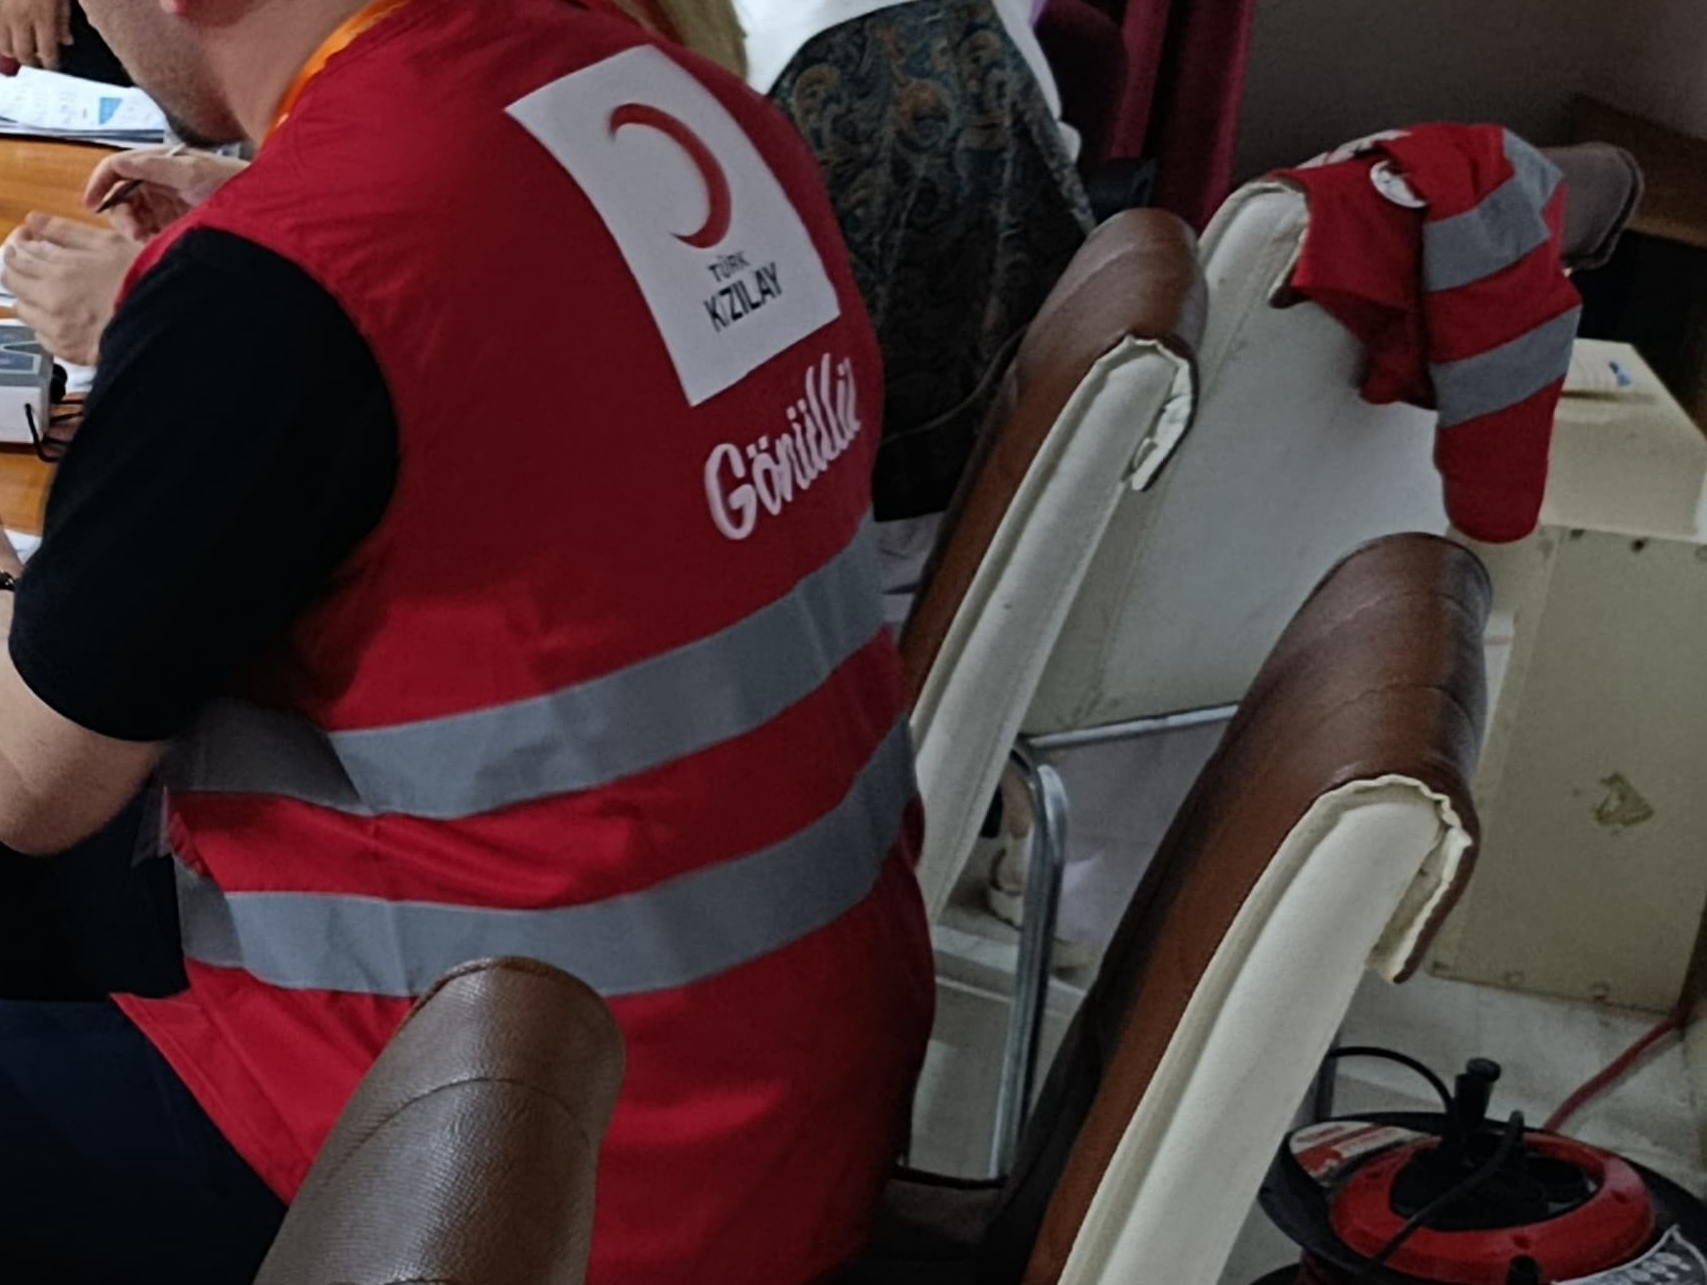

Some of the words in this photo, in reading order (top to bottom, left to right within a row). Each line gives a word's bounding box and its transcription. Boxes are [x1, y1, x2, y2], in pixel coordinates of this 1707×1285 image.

[703, 261, 784, 332] KIZILAY
[707, 250, 753, 283] TÜRK
[704, 351, 861, 541] Gönüllü
